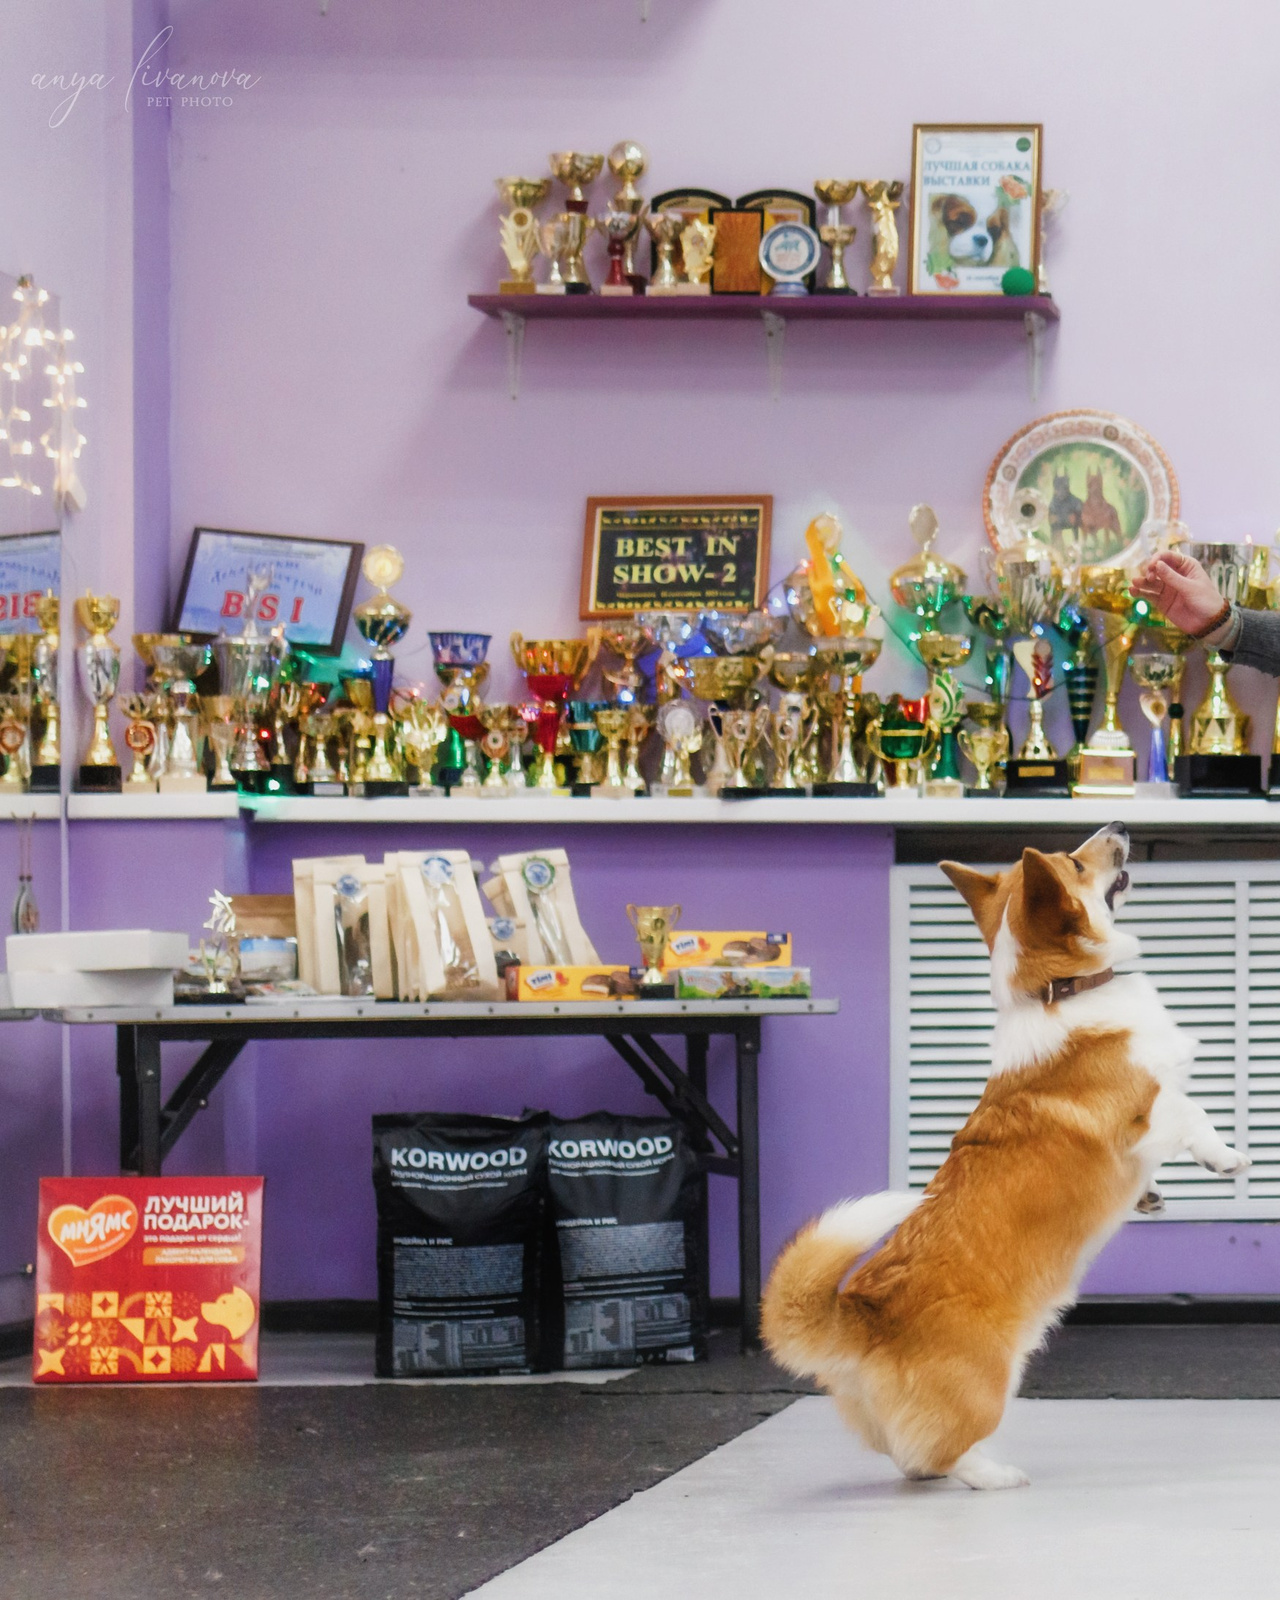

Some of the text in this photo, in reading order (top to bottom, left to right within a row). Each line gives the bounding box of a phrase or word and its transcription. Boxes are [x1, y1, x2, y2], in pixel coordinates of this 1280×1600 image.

[924, 161, 1030, 172] ЛУЧШАЯ СОБАКА
[923, 175, 990, 186] ВЫСТАВКИ
[614, 535, 741, 557] BEST IN
[220, 590, 279, 621] BS
[548, 1136, 673, 1159] KORWOOD
[391, 1147, 527, 1171] KORWOOD
[144, 1191, 244, 1213] ЛУЧШИЙ
[60, 1210, 132, 1244] МНЯМС
